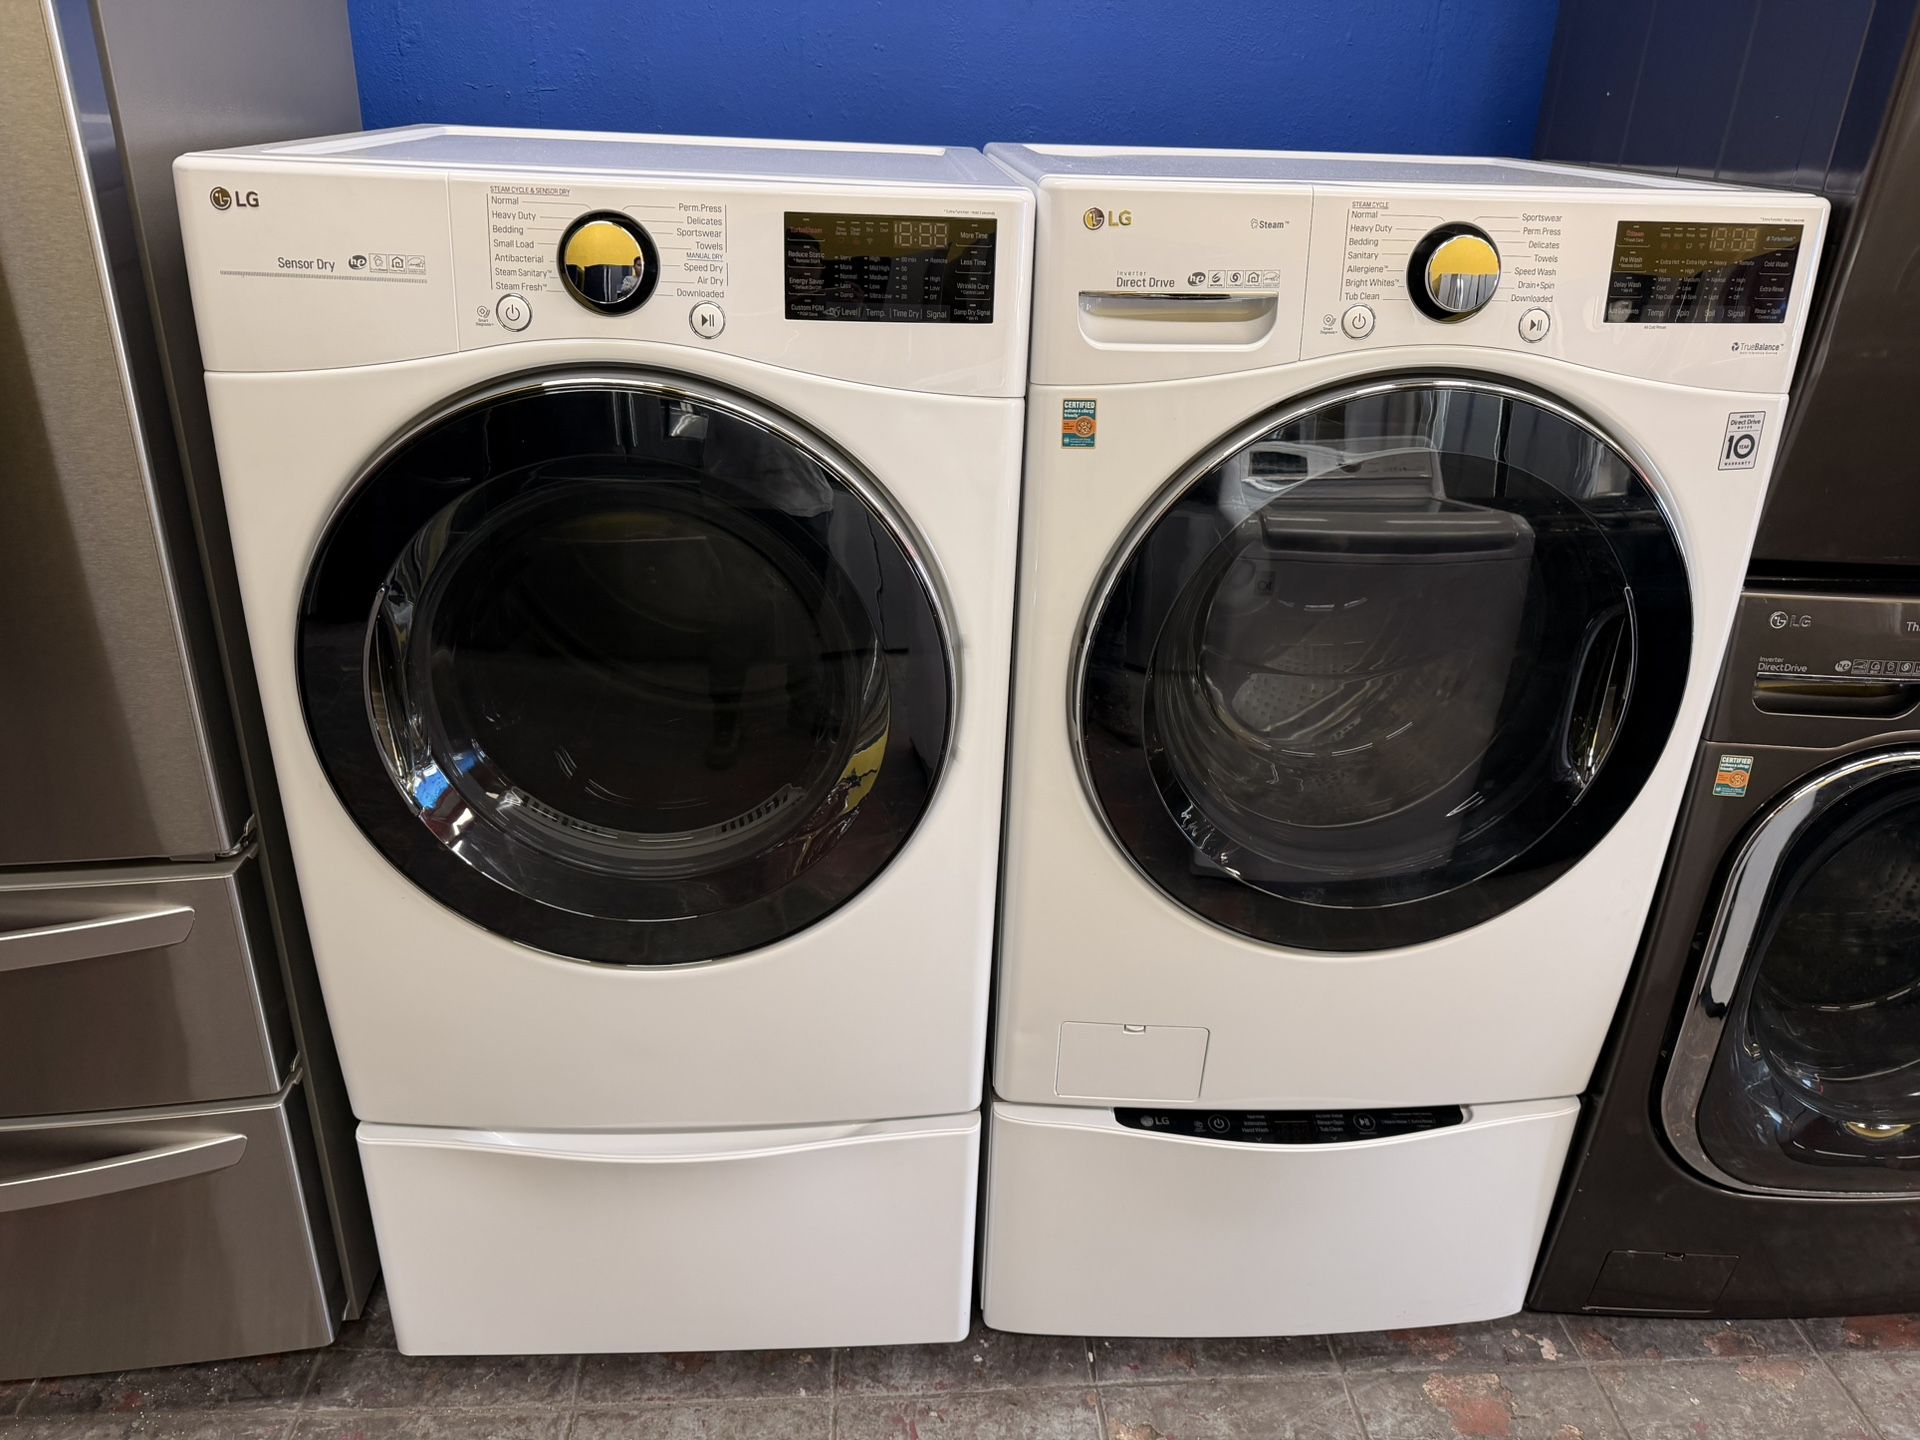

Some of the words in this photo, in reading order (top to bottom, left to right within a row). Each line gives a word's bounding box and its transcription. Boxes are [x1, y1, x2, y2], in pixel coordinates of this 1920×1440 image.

[490, 185, 510, 193] STEAM
[511, 186, 529, 195] CYCLE
[535, 187, 558, 195] SENSOR
[235, 191, 260, 208] LG
[491, 196, 519, 205] Normal
[492, 210, 517, 220] Heavy
[518, 211, 536, 221] Duty
[1108, 209, 1132, 227] LG
[1351, 210, 1378, 219] Normal
[1522, 212, 1562, 222] Sportswear
[687, 216, 722, 226] Delicates
[492, 225, 524, 235] Bedding
[676, 228, 722, 238] Sportswear
[1350, 224, 1373, 233] Heavy
[1375, 224, 1392, 233] Duty
[960, 231, 974, 239] More
[493, 239, 515, 248] Small
[515, 240, 535, 249] Load
[696, 241, 723, 251] Towels
[1348, 238, 1379, 247] Bedding
[1528, 240, 1560, 249] Delicates
[494, 254, 544, 263] Antibacterial
[1348, 251, 1379, 261] Sanitary
[1534, 254, 1558, 263] Towels
[277, 257, 314, 271] Sensor
[317, 258, 336, 272] Dry
[683, 262, 708, 272] Speed
[710, 264, 724, 274] Dry
[495, 267, 517, 277] Steam
[1514, 266, 1536, 276] Speed
[1537, 267, 1557, 276] Wash
[697, 276, 708, 284] Air
[710, 276, 724, 286] Dry
[789, 277, 808, 285] Energy
[1116, 277, 1147, 288] Direct
[1149, 278, 1175, 288] Drive
[1345, 279, 1369, 288] Bright
[495, 282, 520, 291] Steam
[956, 282, 977, 290] Wrinkle
[676, 288, 725, 298] Downloaded
[1345, 292, 1358, 300] Tub
[1359, 292, 1380, 300] Clean
[1511, 294, 1553, 303] Downloaded
[841, 307, 858, 316] Level
[908, 310, 920, 319] Dry
[926, 310, 947, 319] Signal
[954, 308, 967, 316] Damp
[967, 309, 976, 317] Dry
[976, 309, 991, 317] Signal
[1677, 309, 1690, 318] Spin
[1704, 310, 1716, 318] Soil
[1727, 310, 1746, 319] Signal
[1726, 434, 1756, 460] 10
[1790, 615, 1812, 628] LG
[1155, 1117, 1170, 1126] LG
